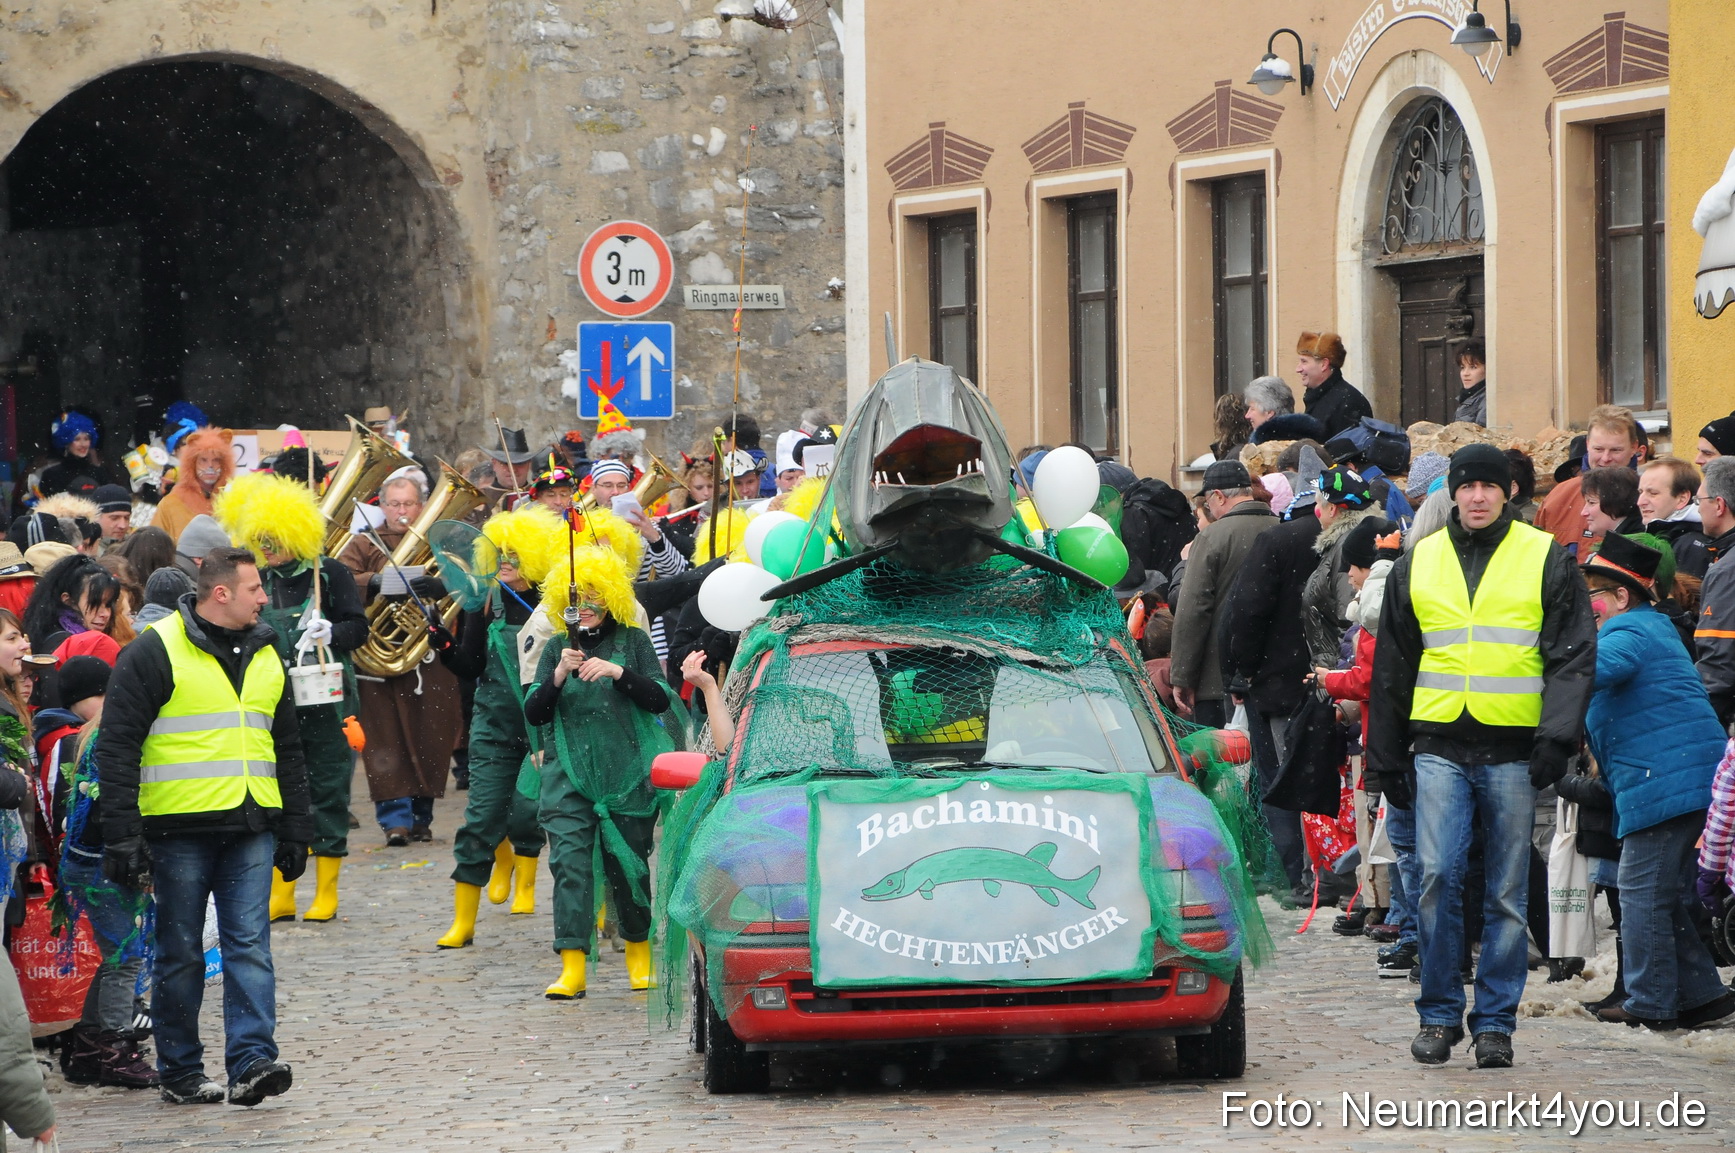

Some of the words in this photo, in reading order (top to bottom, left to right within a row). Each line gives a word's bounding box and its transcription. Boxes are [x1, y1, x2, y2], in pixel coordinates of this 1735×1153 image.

[1338, 3, 1385, 78] Bistro
[607, 251, 621, 285] 3
[629, 269, 645, 286] m
[692, 290, 780, 306] Ringmauerweg
[856, 792, 1101, 857] Bachamini
[830, 905, 1129, 965] HECHTENFÄNGER
